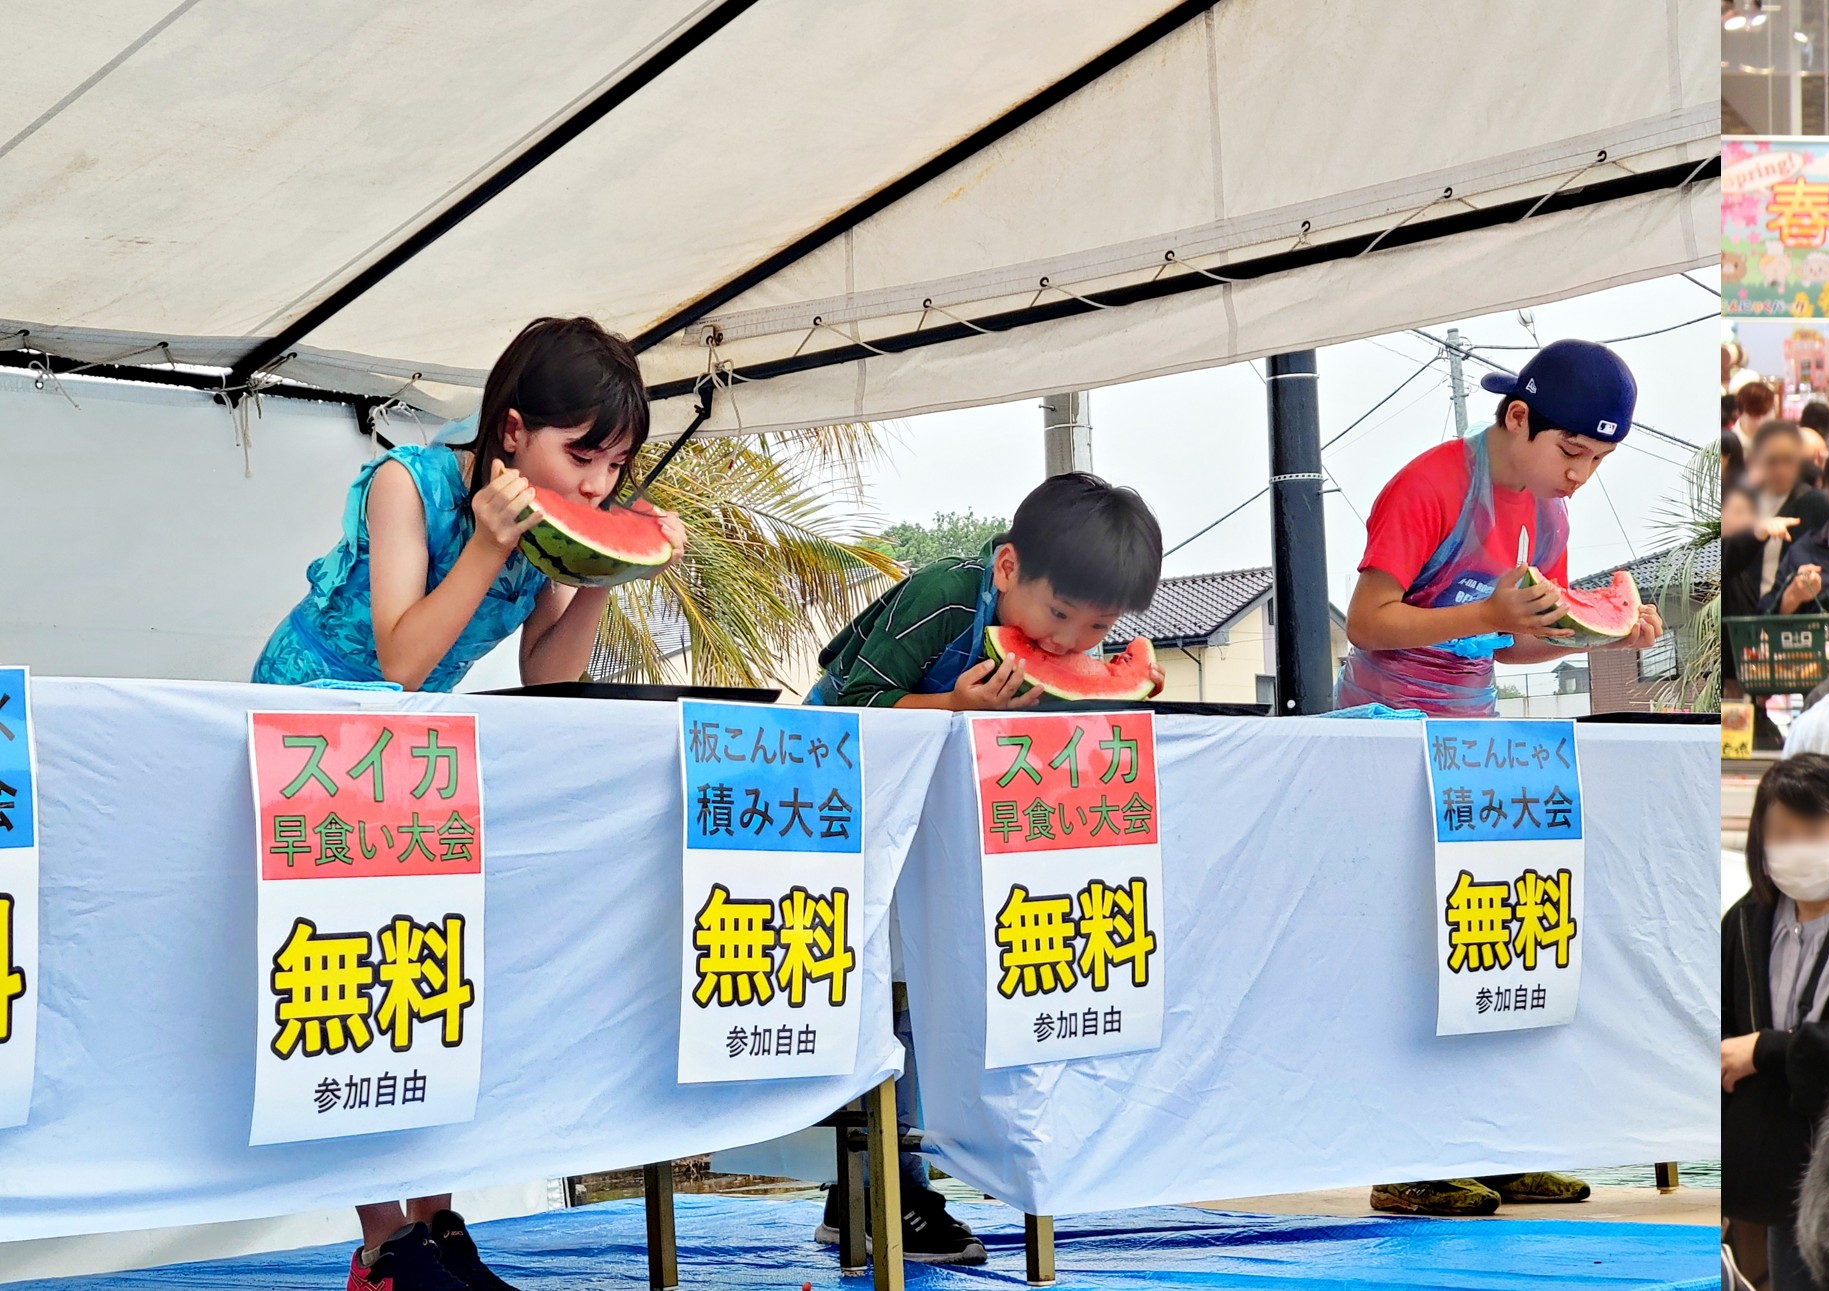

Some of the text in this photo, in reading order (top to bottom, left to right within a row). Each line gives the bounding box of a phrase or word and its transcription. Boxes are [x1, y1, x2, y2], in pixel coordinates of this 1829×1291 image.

[281, 729, 460, 801] スイカ
[689, 719, 856, 771] 板こんにゃく
[996, 725, 1139, 789] スイカ
[1433, 734, 1572, 773] 板こんにゃく
[696, 783, 854, 843] 積み大会
[989, 794, 1154, 844] 早食い大会
[1443, 784, 1574, 832] 積み大会
[269, 811, 477, 869] 早食い大会
[694, 882, 856, 1009] 無料
[995, 876, 1157, 1000] 無料
[1446, 868, 1577, 975] 無料
[272, 913, 475, 1061] 無料
[1476, 984, 1547, 1014] 参加自由
[726, 1024, 817, 1059] 参加自由
[1033, 1008, 1122, 1043] 参加自由
[313, 1069, 427, 1114] 参加自由
